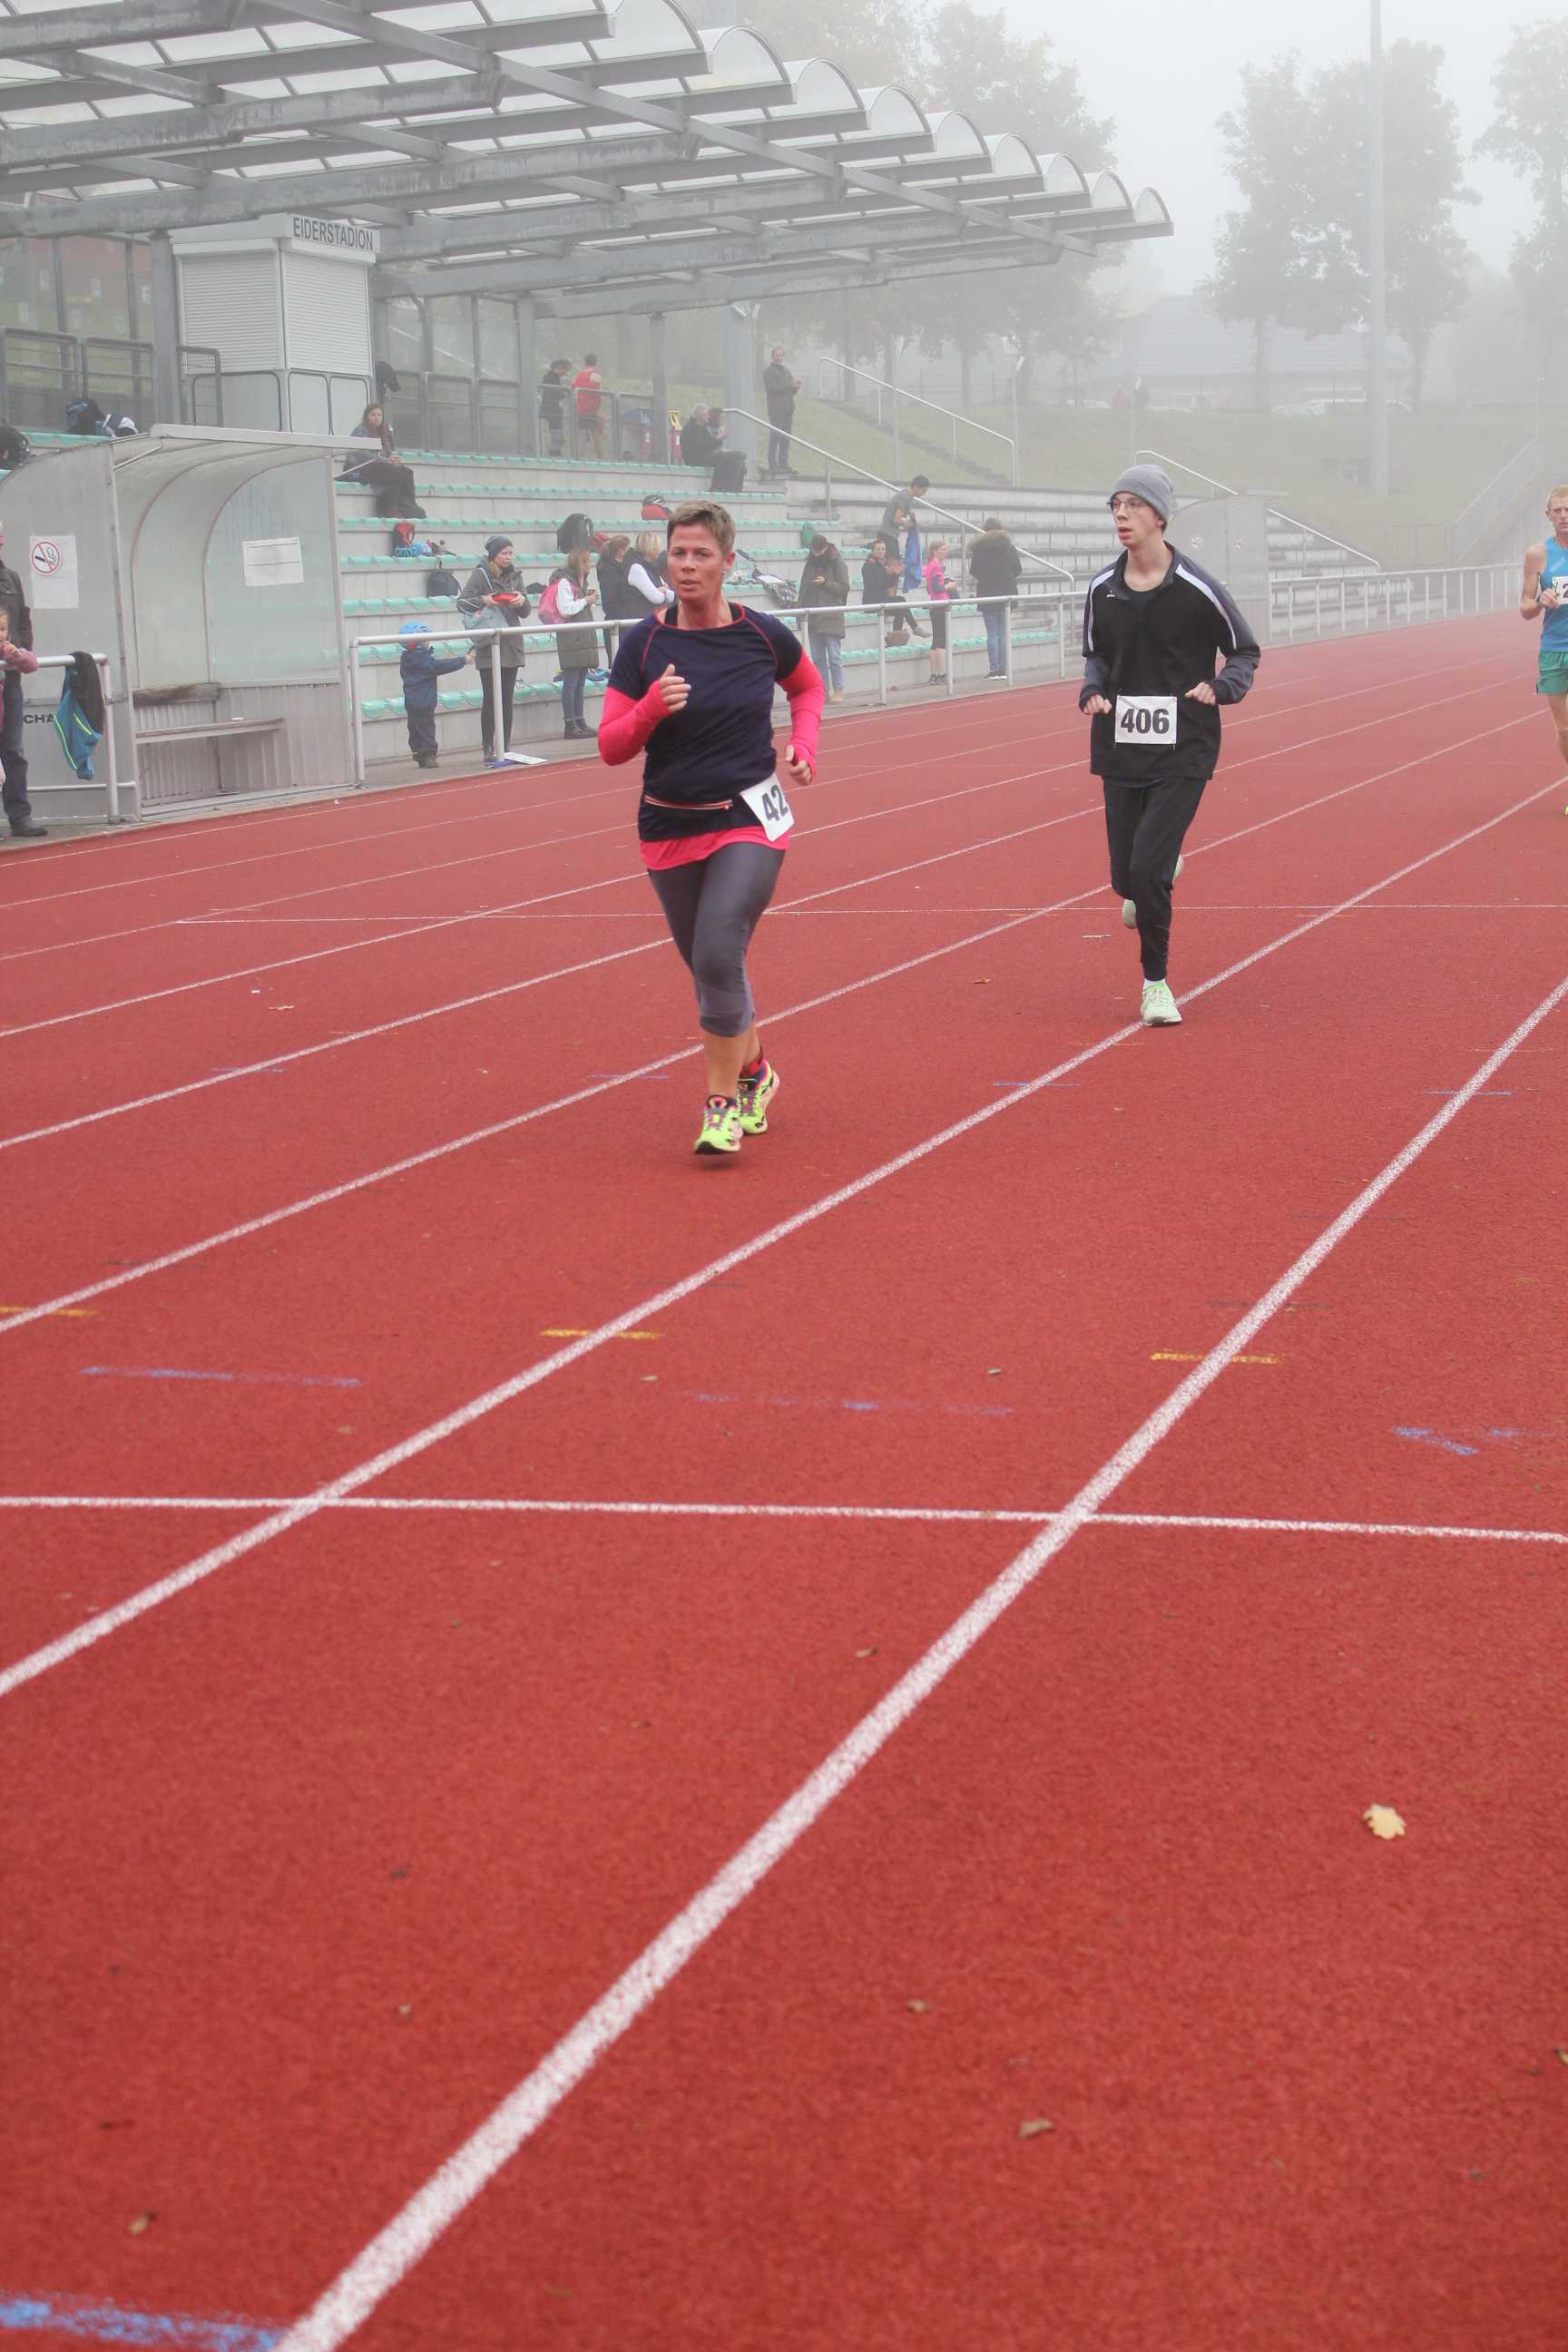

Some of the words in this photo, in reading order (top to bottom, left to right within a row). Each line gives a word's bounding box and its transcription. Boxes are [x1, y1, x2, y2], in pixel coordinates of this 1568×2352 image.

[293, 218, 373, 250] EIDERSTADION
[1120, 708, 1170, 734] 406
[762, 784, 789, 821] 42
